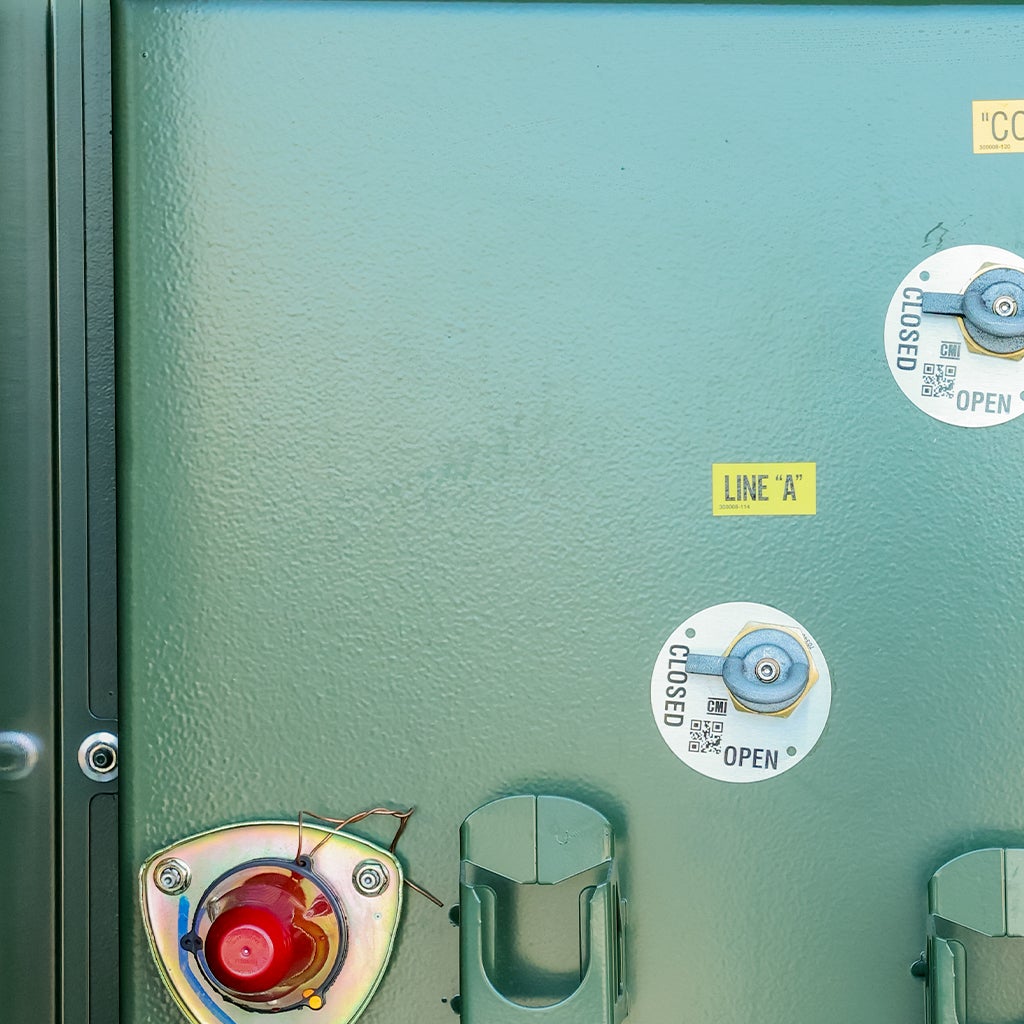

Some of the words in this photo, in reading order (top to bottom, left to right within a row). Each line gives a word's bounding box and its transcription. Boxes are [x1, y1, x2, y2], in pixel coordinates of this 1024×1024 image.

[897, 287, 923, 371] CLOSED
[940, 343, 960, 358] CMI
[956, 389, 1012, 414] OPEN
[725, 475, 768, 501] LINE
[663, 644, 690, 727] CLOSED
[707, 699, 728, 714] CMI
[723, 745, 779, 770] OPEN
